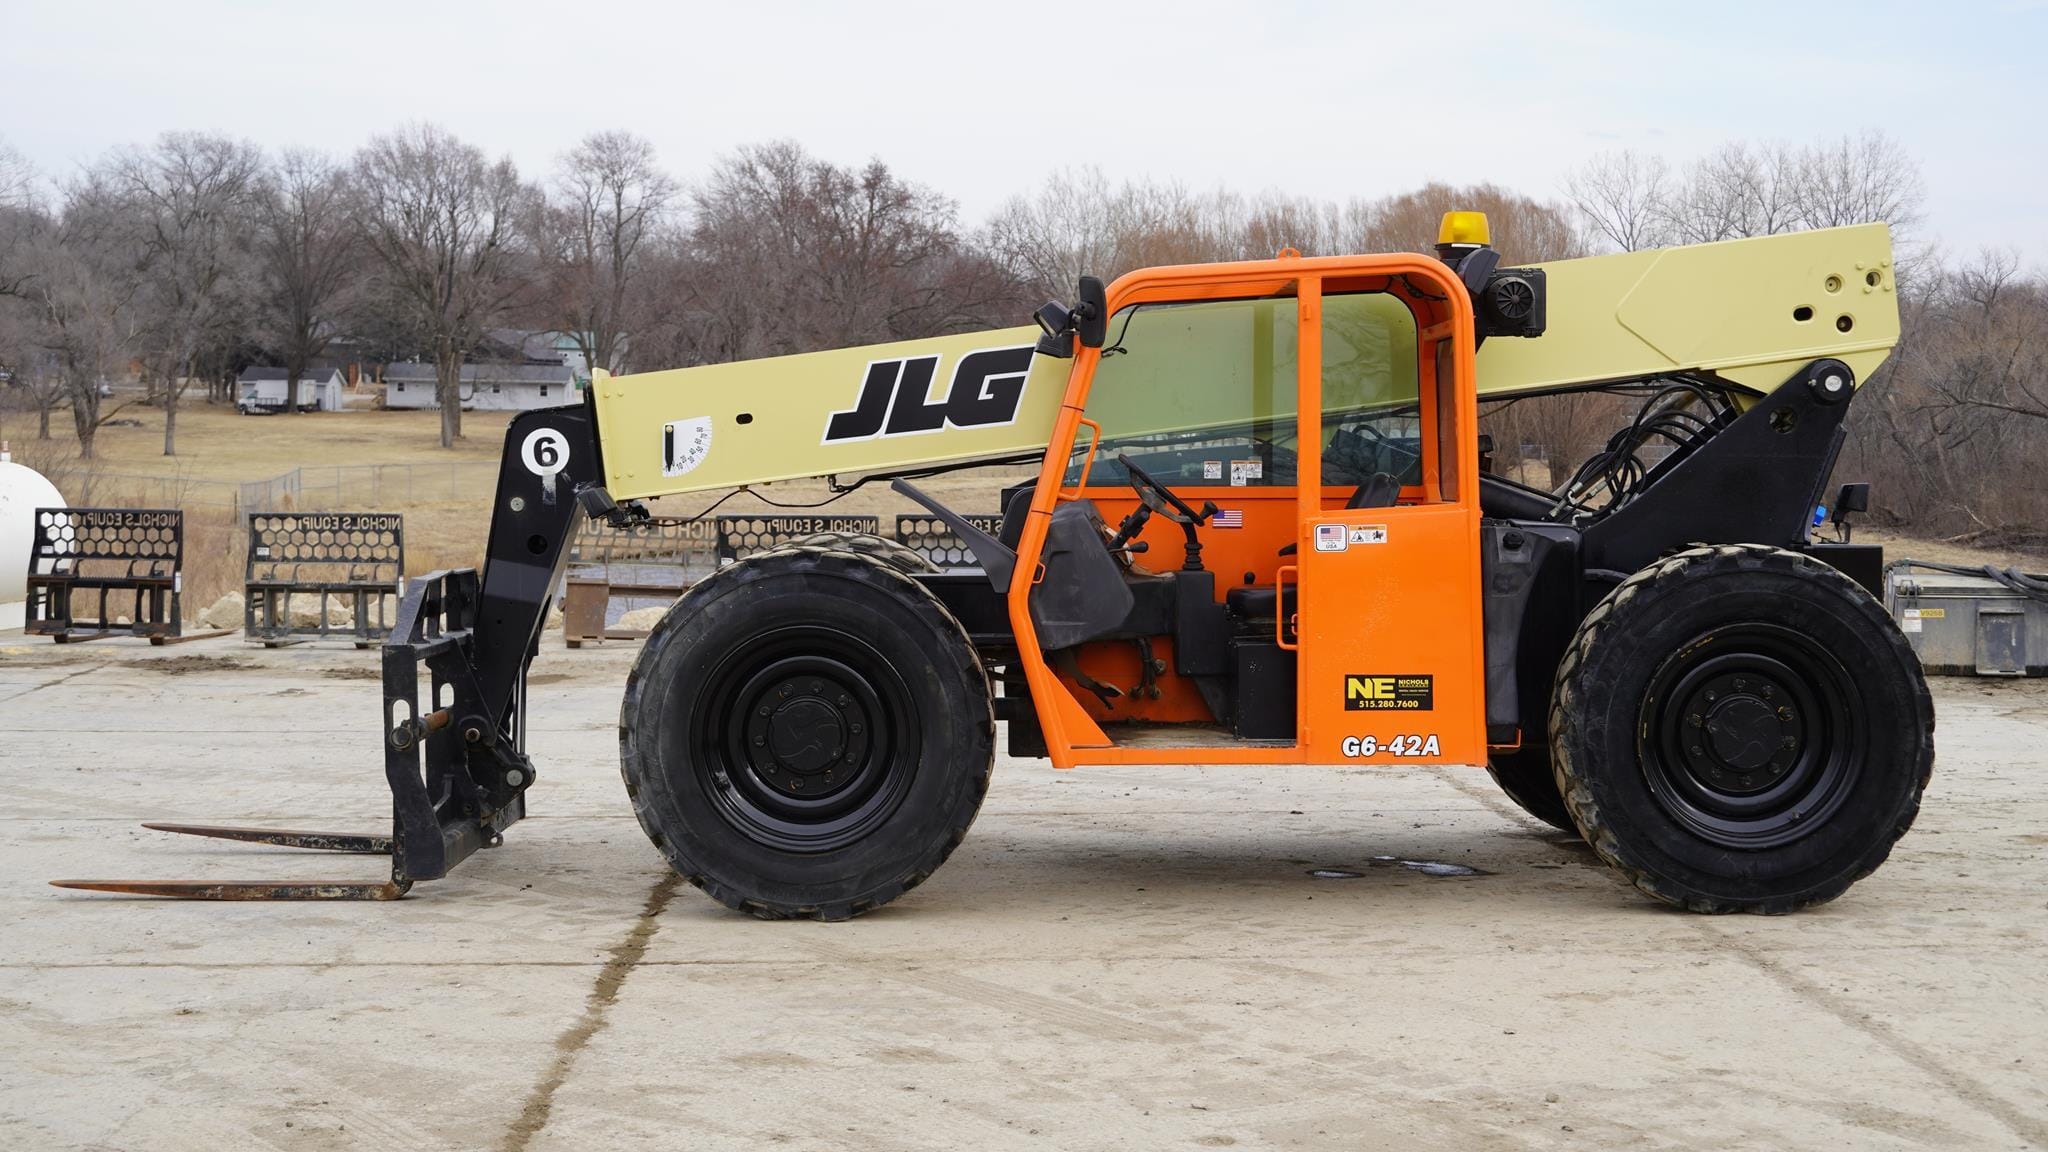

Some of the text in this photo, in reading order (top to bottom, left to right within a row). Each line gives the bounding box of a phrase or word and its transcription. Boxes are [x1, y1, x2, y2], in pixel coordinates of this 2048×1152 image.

[820, 343, 1038, 446] JLG
[533, 436, 558, 467] 6
[1348, 678, 1395, 699] NE
[1359, 700, 1419, 708] 515.280.7600
[1342, 734, 1441, 757] G6-42A
